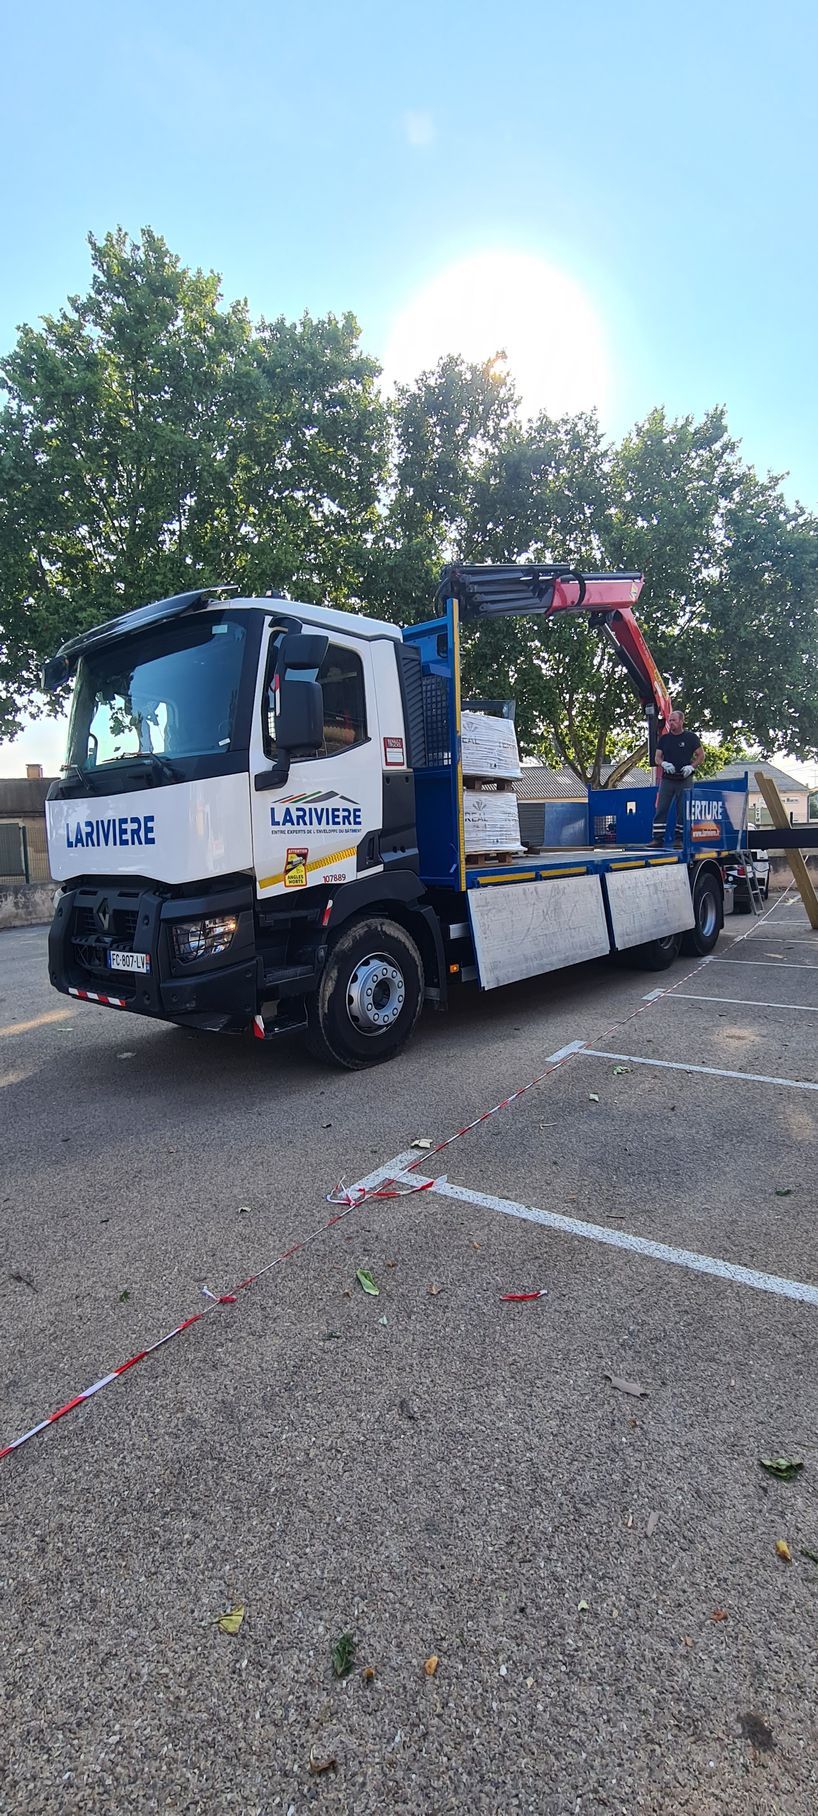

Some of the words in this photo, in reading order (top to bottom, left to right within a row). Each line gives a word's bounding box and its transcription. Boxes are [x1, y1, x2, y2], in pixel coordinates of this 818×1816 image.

[270, 807, 362, 826] LARIVIERE
[66, 815, 156, 848] LARIVIERE
[322, 873, 347, 883] 107889
[111, 953, 145, 969] FC-807-LV
